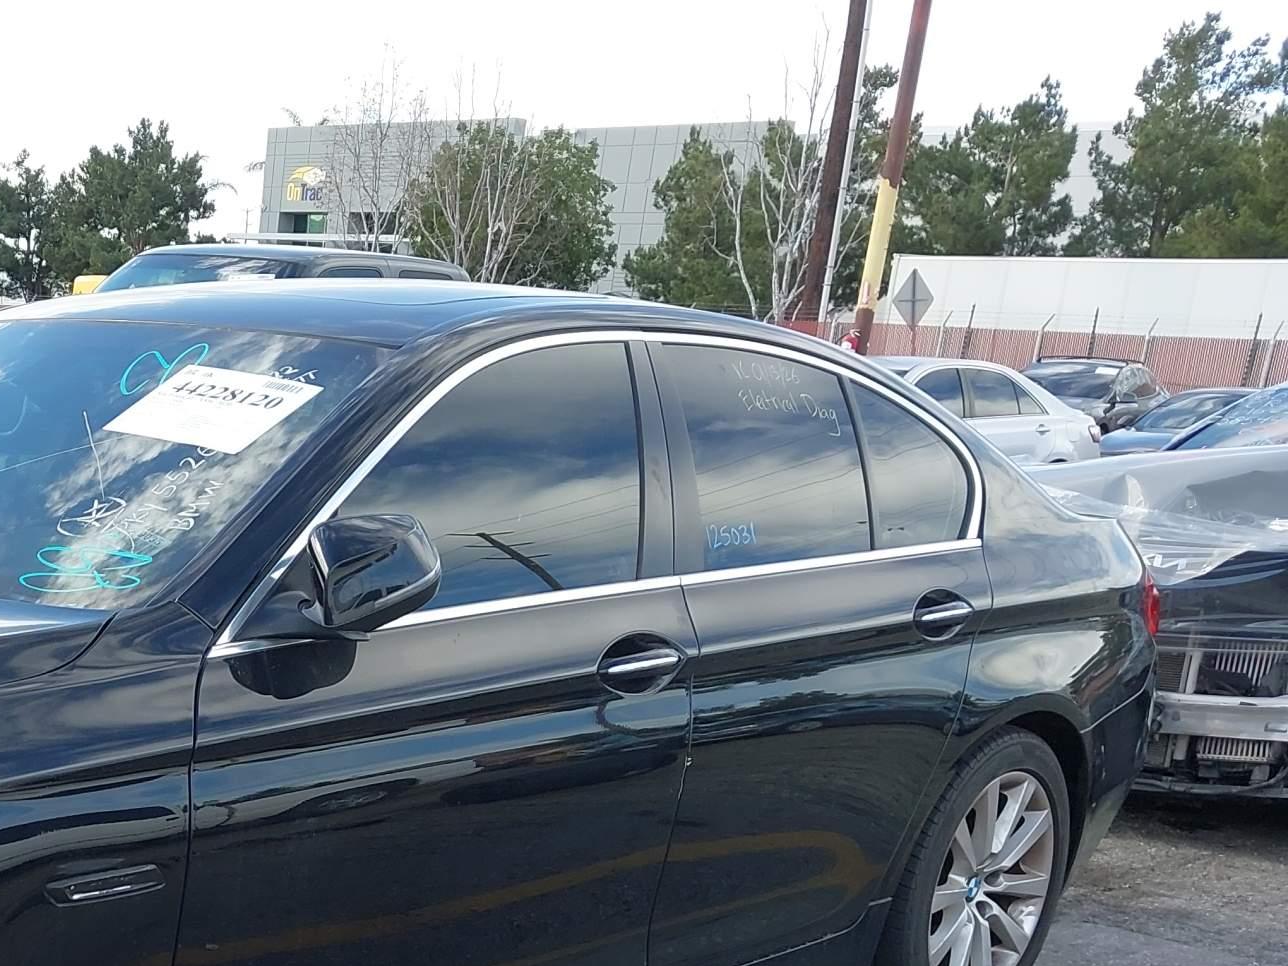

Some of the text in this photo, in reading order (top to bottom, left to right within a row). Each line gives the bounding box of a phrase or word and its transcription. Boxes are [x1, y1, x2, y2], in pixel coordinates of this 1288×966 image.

[288, 182, 323, 201] OnTrac
[172, 380, 284, 409] 44228120
[169, 480, 224, 531] BMW
[705, 520, 757, 550] 125031
